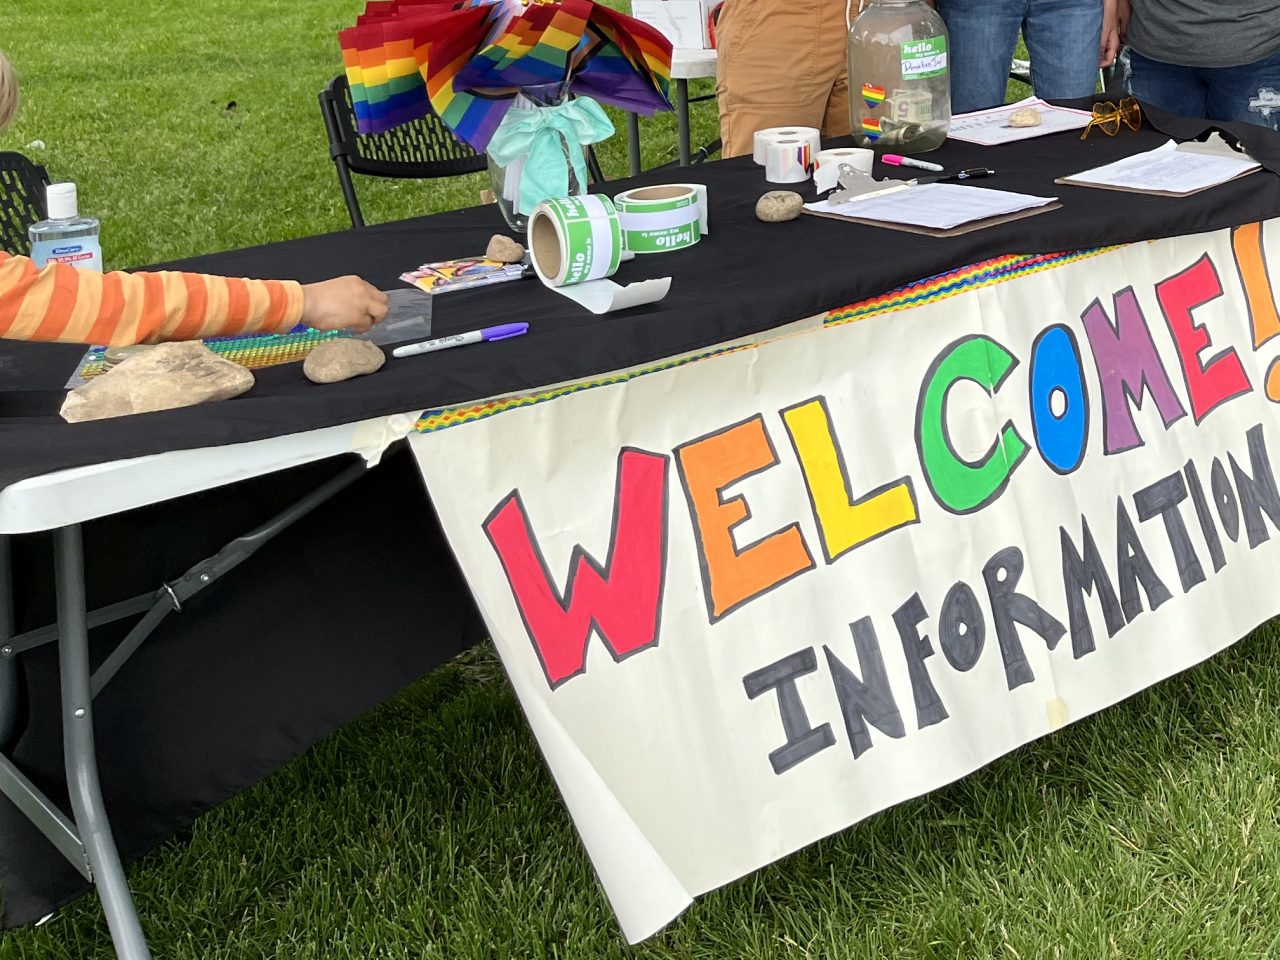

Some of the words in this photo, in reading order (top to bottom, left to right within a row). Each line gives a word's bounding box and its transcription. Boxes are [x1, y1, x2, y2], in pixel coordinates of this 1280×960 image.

[903, 42, 932, 54] hello
[655, 230, 691, 248] hello
[566, 252, 586, 284] hello
